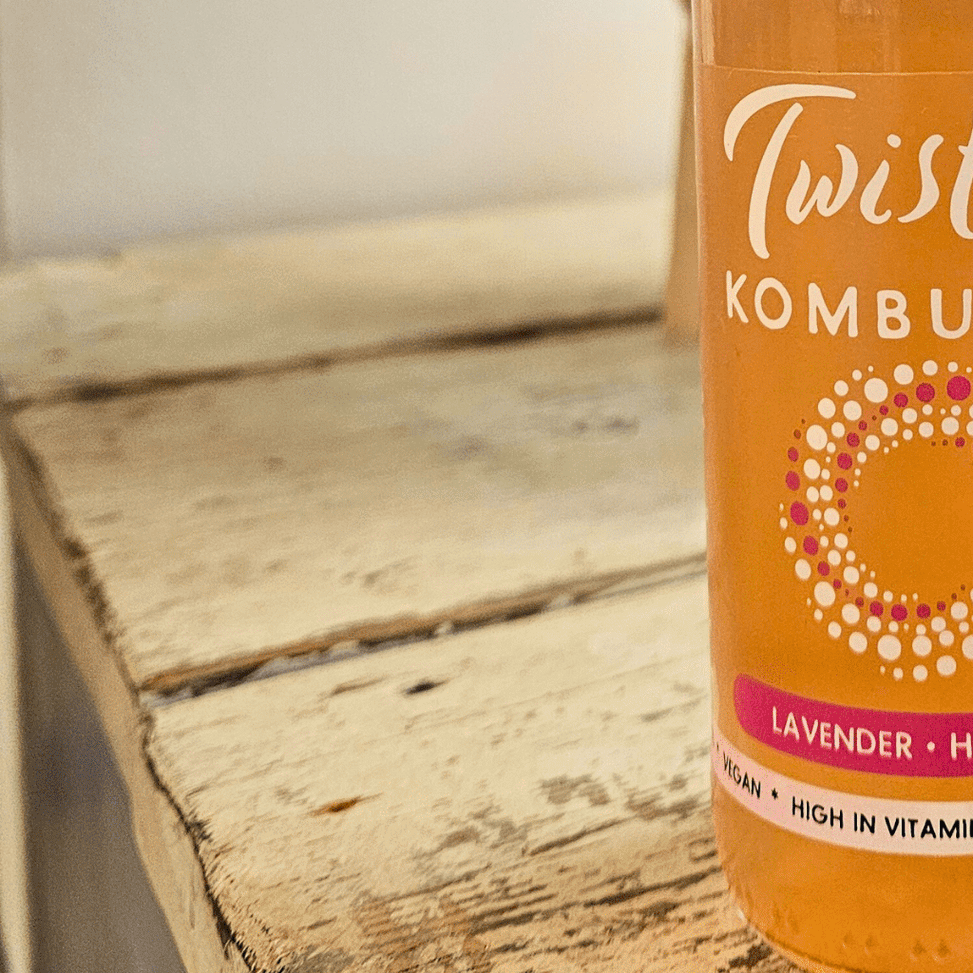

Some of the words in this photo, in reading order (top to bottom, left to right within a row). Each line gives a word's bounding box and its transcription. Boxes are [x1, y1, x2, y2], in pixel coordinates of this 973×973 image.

[772, 705, 913, 761] LAVENDER
[722, 751, 762, 800] VEGAN
[791, 795, 845, 830] HIGH
[853, 811, 877, 835] IN
